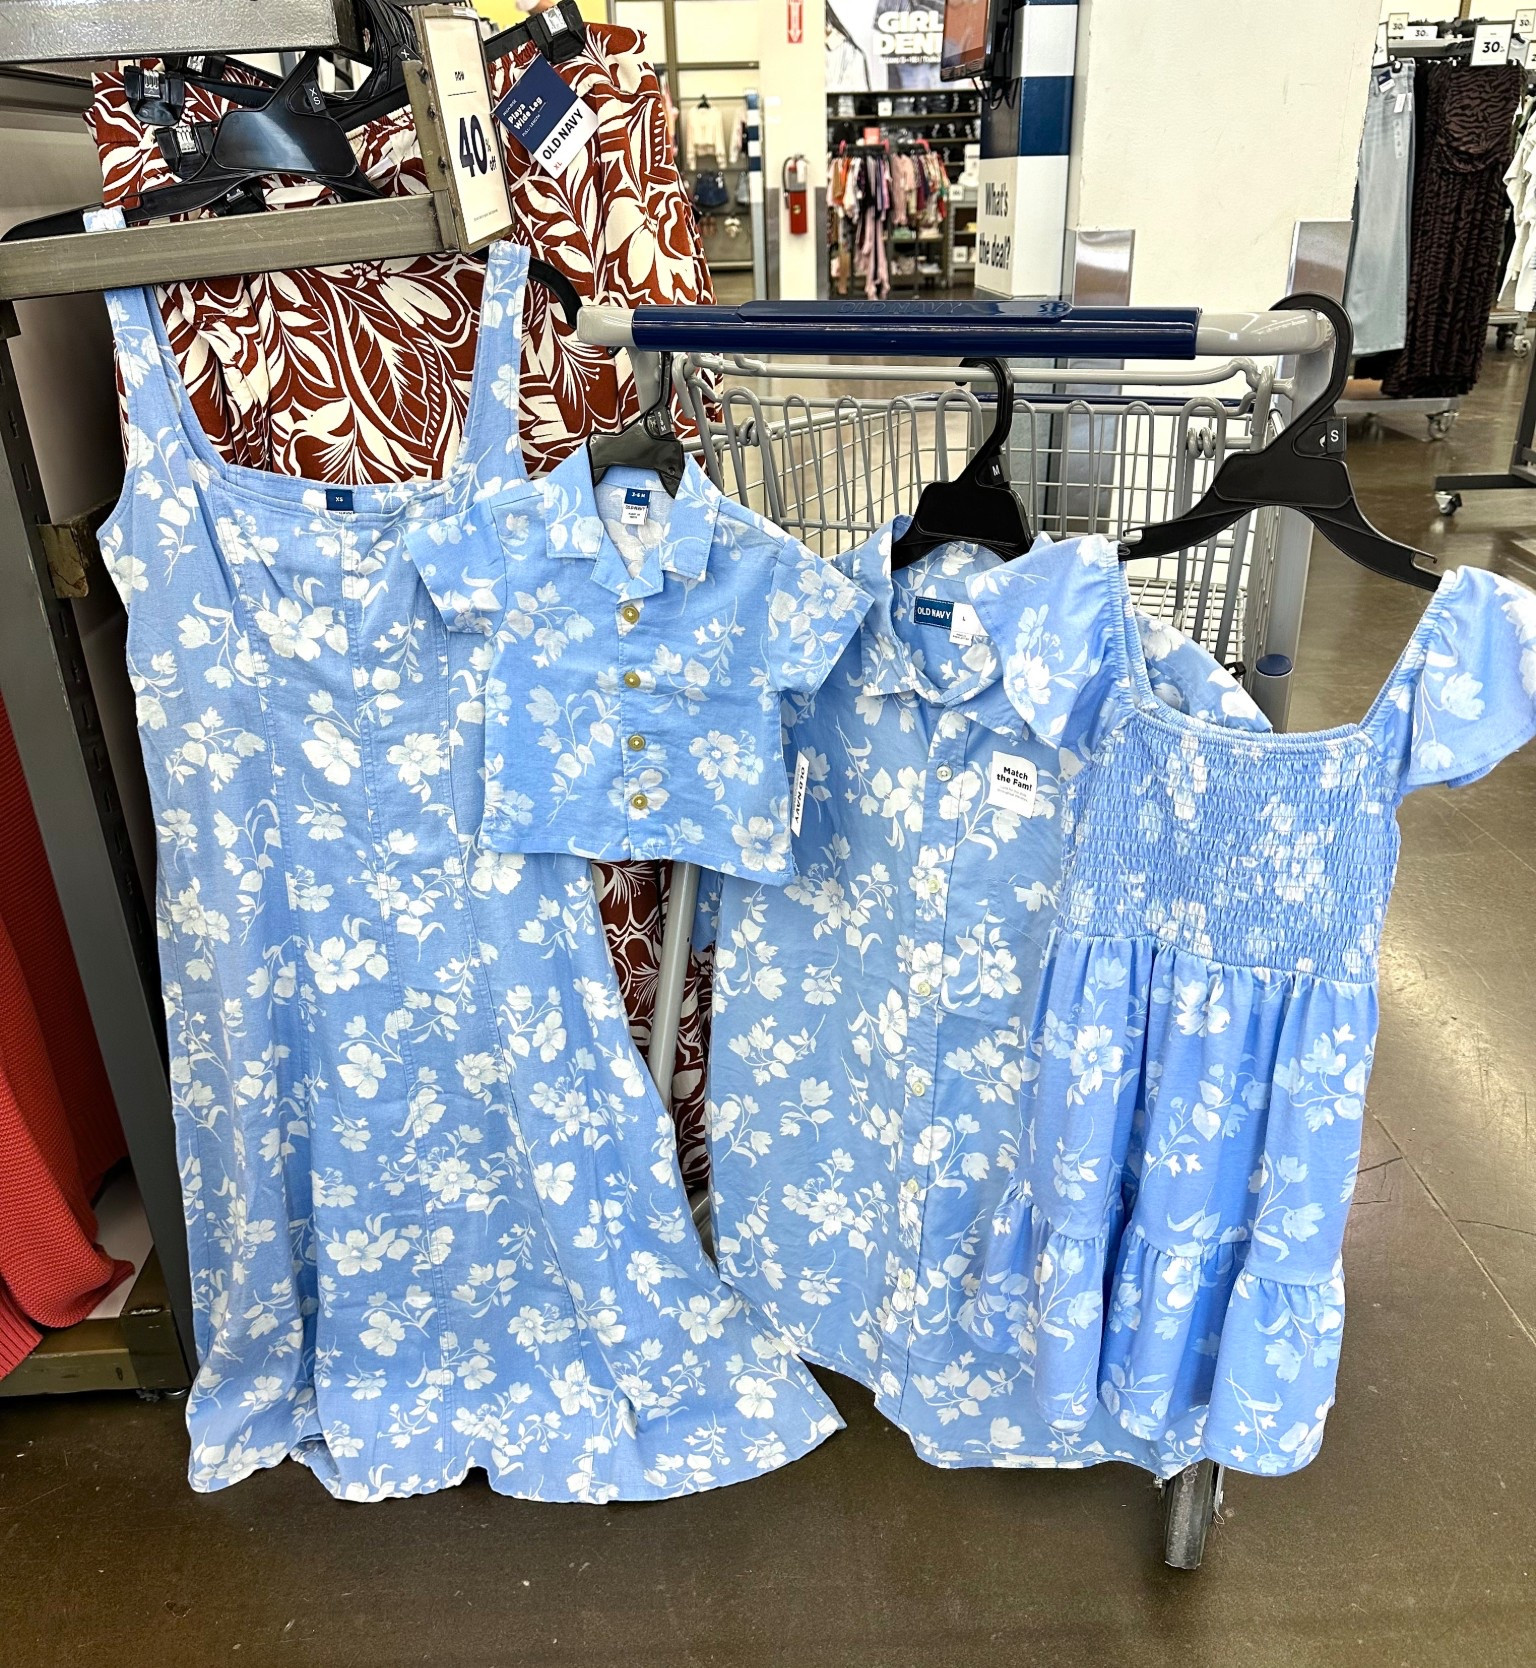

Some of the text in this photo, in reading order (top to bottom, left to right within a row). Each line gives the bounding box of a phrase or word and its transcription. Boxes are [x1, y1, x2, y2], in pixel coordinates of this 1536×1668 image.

[878, 10, 944, 33] GIRL
[1482, 41, 1501, 54] 30
[309, 87, 321, 106] XS
[507, 103, 527, 125] Playa
[513, 96, 543, 130] Wide Leg
[542, 108, 584, 160] OLD NAVY
[459, 114, 488, 178] 40
[553, 161, 563, 172] XL
[985, 182, 1009, 217] What's
[979, 232, 1011, 270] the deal?
[838, 302, 963, 315] OLD NAVY
[1330, 429, 1340, 442] S
[992, 465, 1001, 476] M
[917, 607, 952, 620] OLD NAVY
[996, 773, 1011, 784] the
[1013, 778, 1033, 792] Fam!
[1003, 766, 1028, 781] Match
